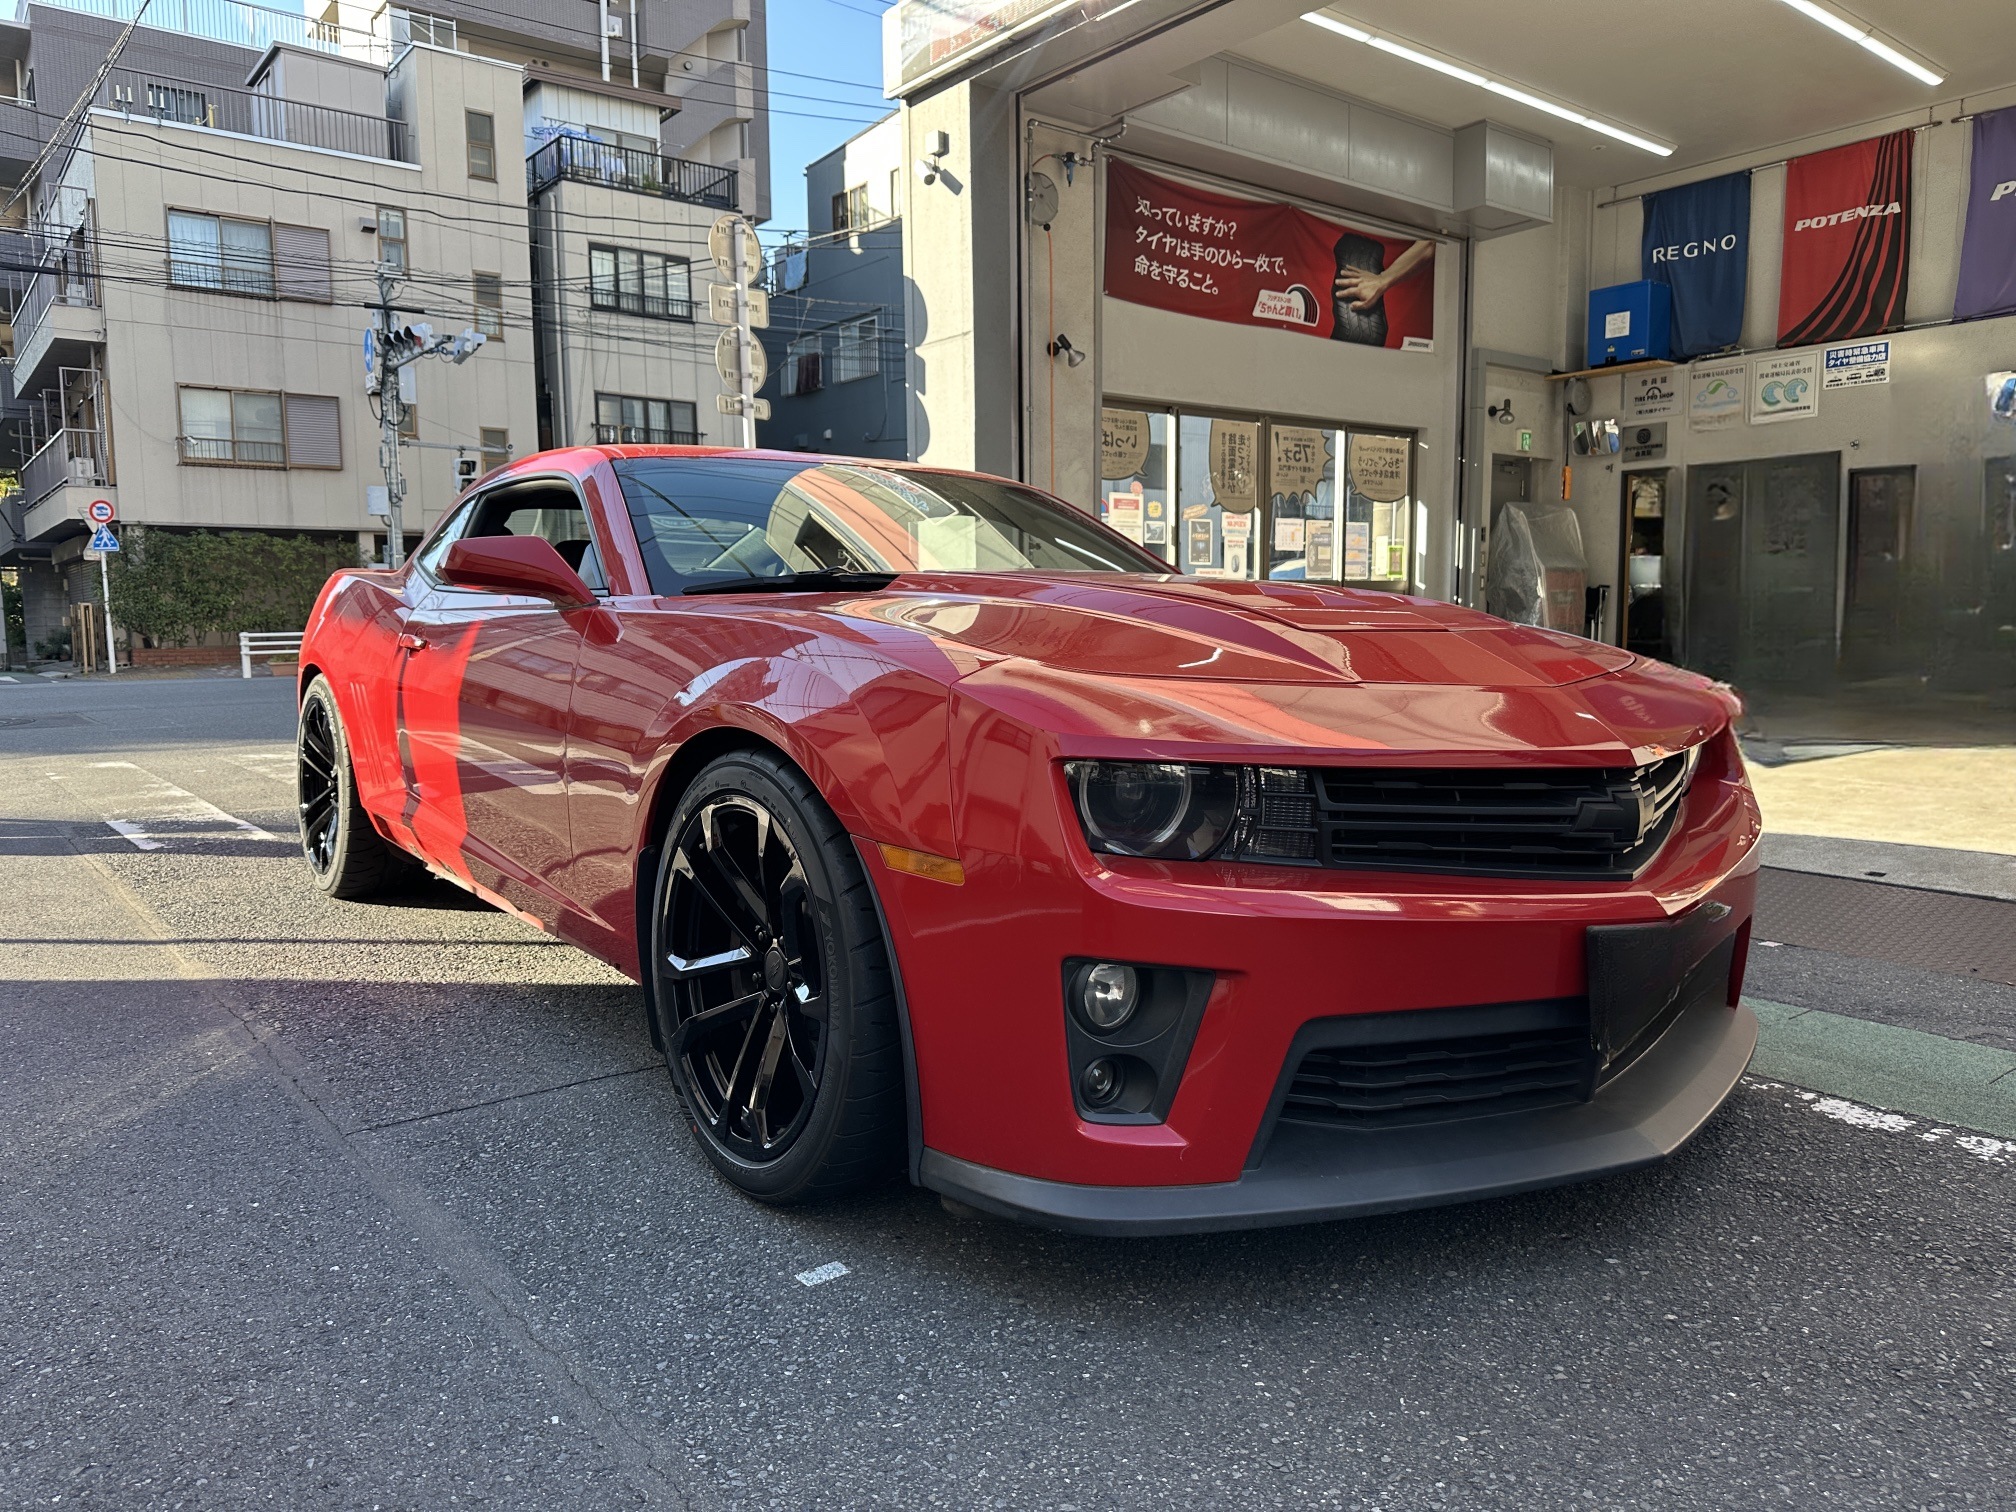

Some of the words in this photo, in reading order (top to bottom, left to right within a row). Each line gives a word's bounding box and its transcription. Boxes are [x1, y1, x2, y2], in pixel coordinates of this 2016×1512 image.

[1990, 180, 2016, 202] P
[1134, 195, 1238, 240] 知っていますか?
[1794, 201, 1902, 231] POTENZA
[1134, 226, 1288, 276] タイヤは手のひら一枚で、
[1652, 233, 1737, 264] REGNO
[1134, 254, 1220, 296] 命を守ること。
[1828, 352, 1887, 367] タイヤ整備協力店
[824, 930, 842, 1033] YOKOHAMA
